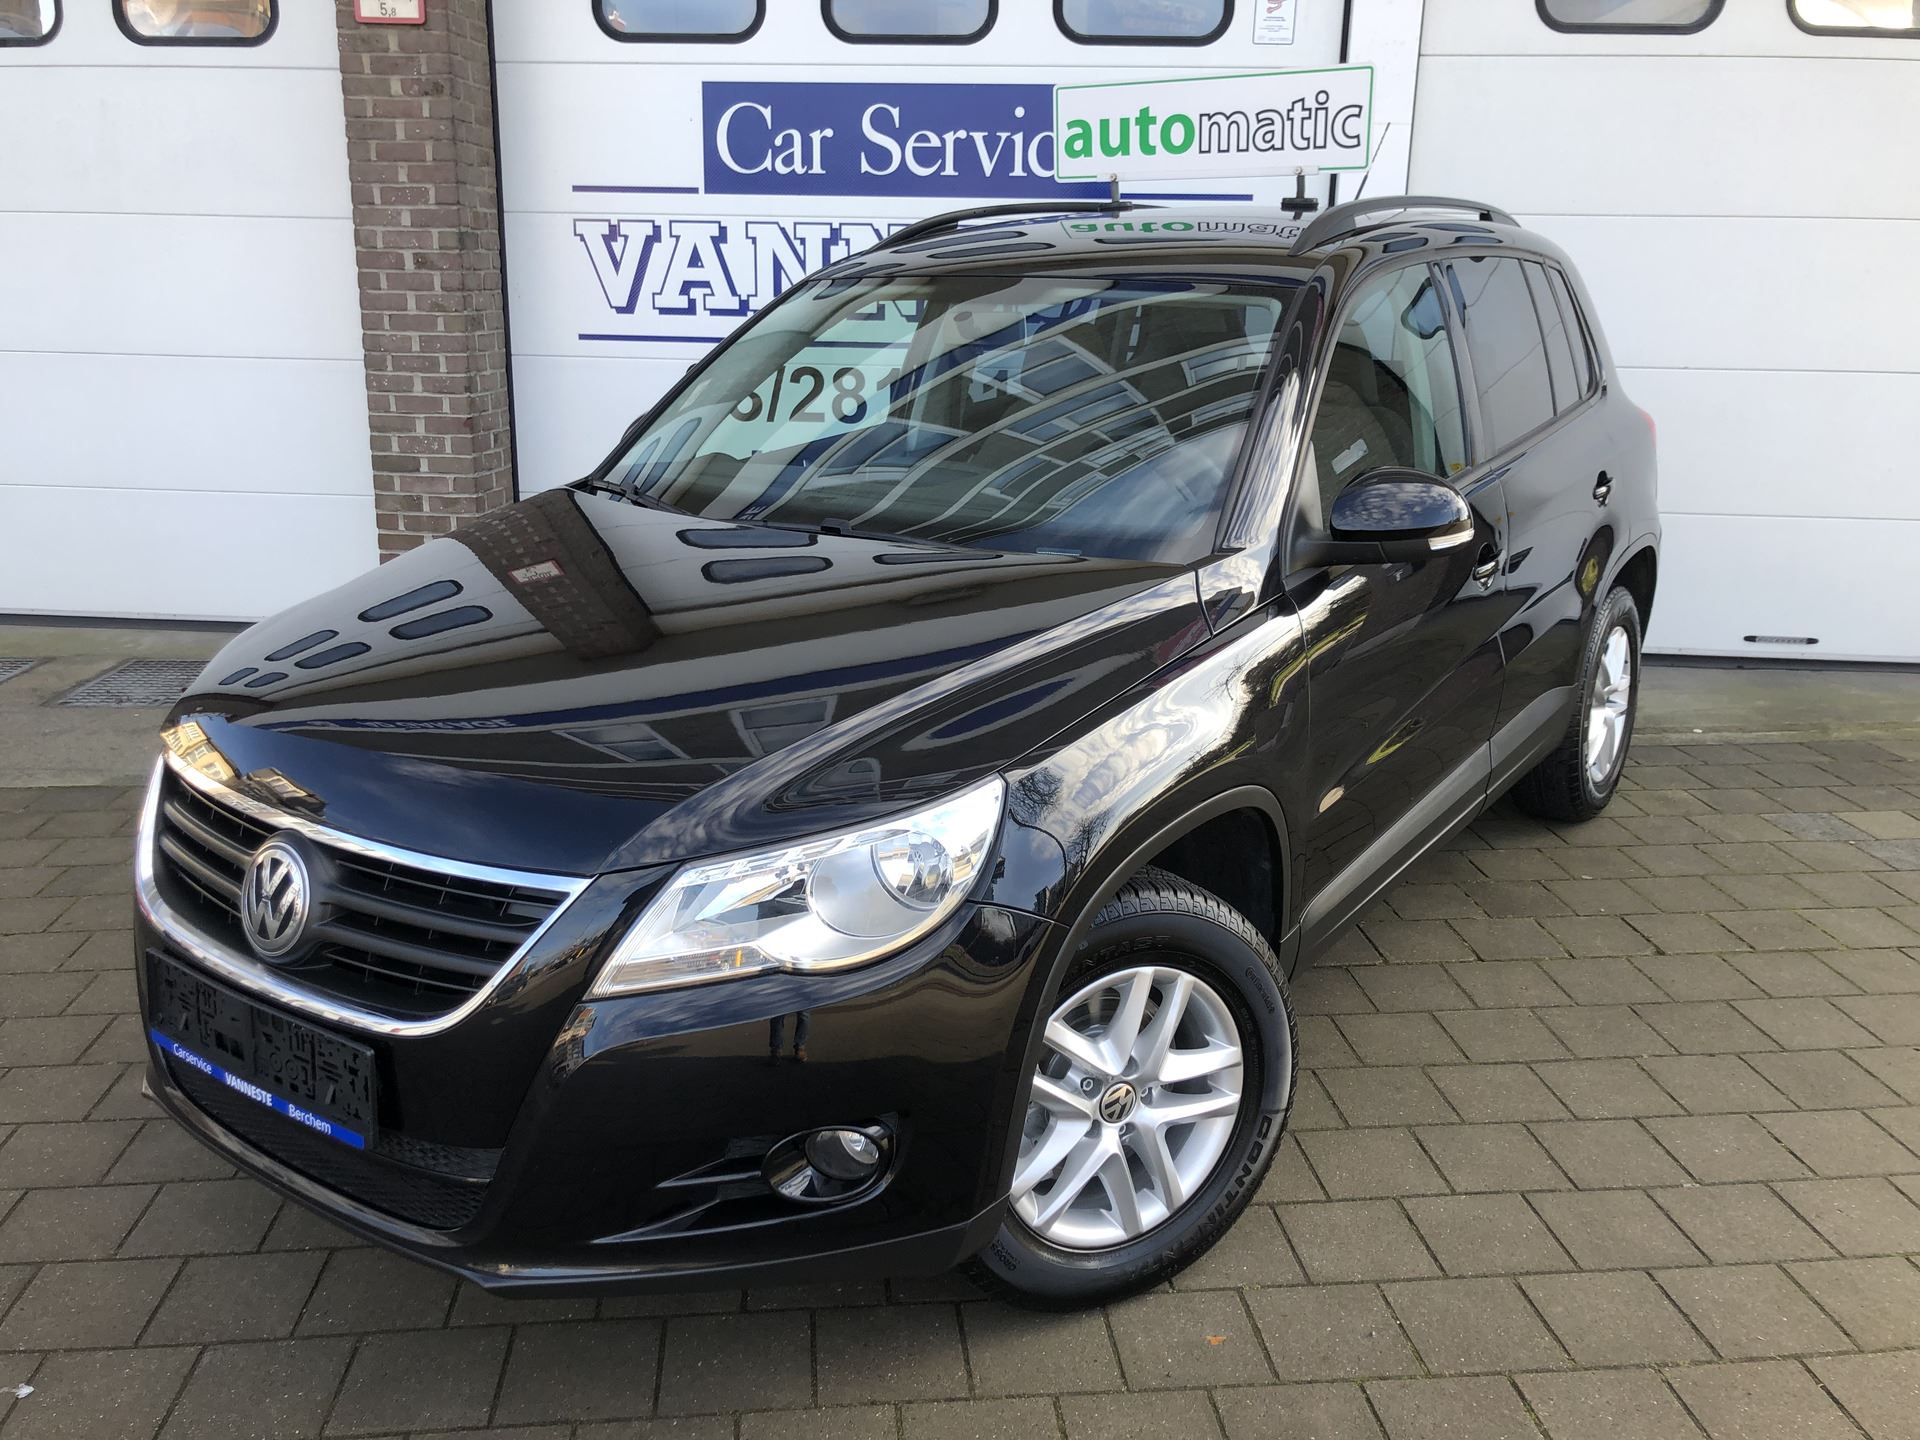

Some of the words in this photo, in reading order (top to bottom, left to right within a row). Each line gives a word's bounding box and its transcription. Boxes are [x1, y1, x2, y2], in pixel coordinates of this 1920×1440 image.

[716, 102, 834, 176] Car
[860, 103, 1055, 178] Servic
[1064, 90, 1363, 159] automatic
[245, 847, 306, 948] VW
[173, 1043, 212, 1075] Carservice
[225, 1072, 273, 1107] VANNESTE
[288, 1104, 332, 1135] Berchem
